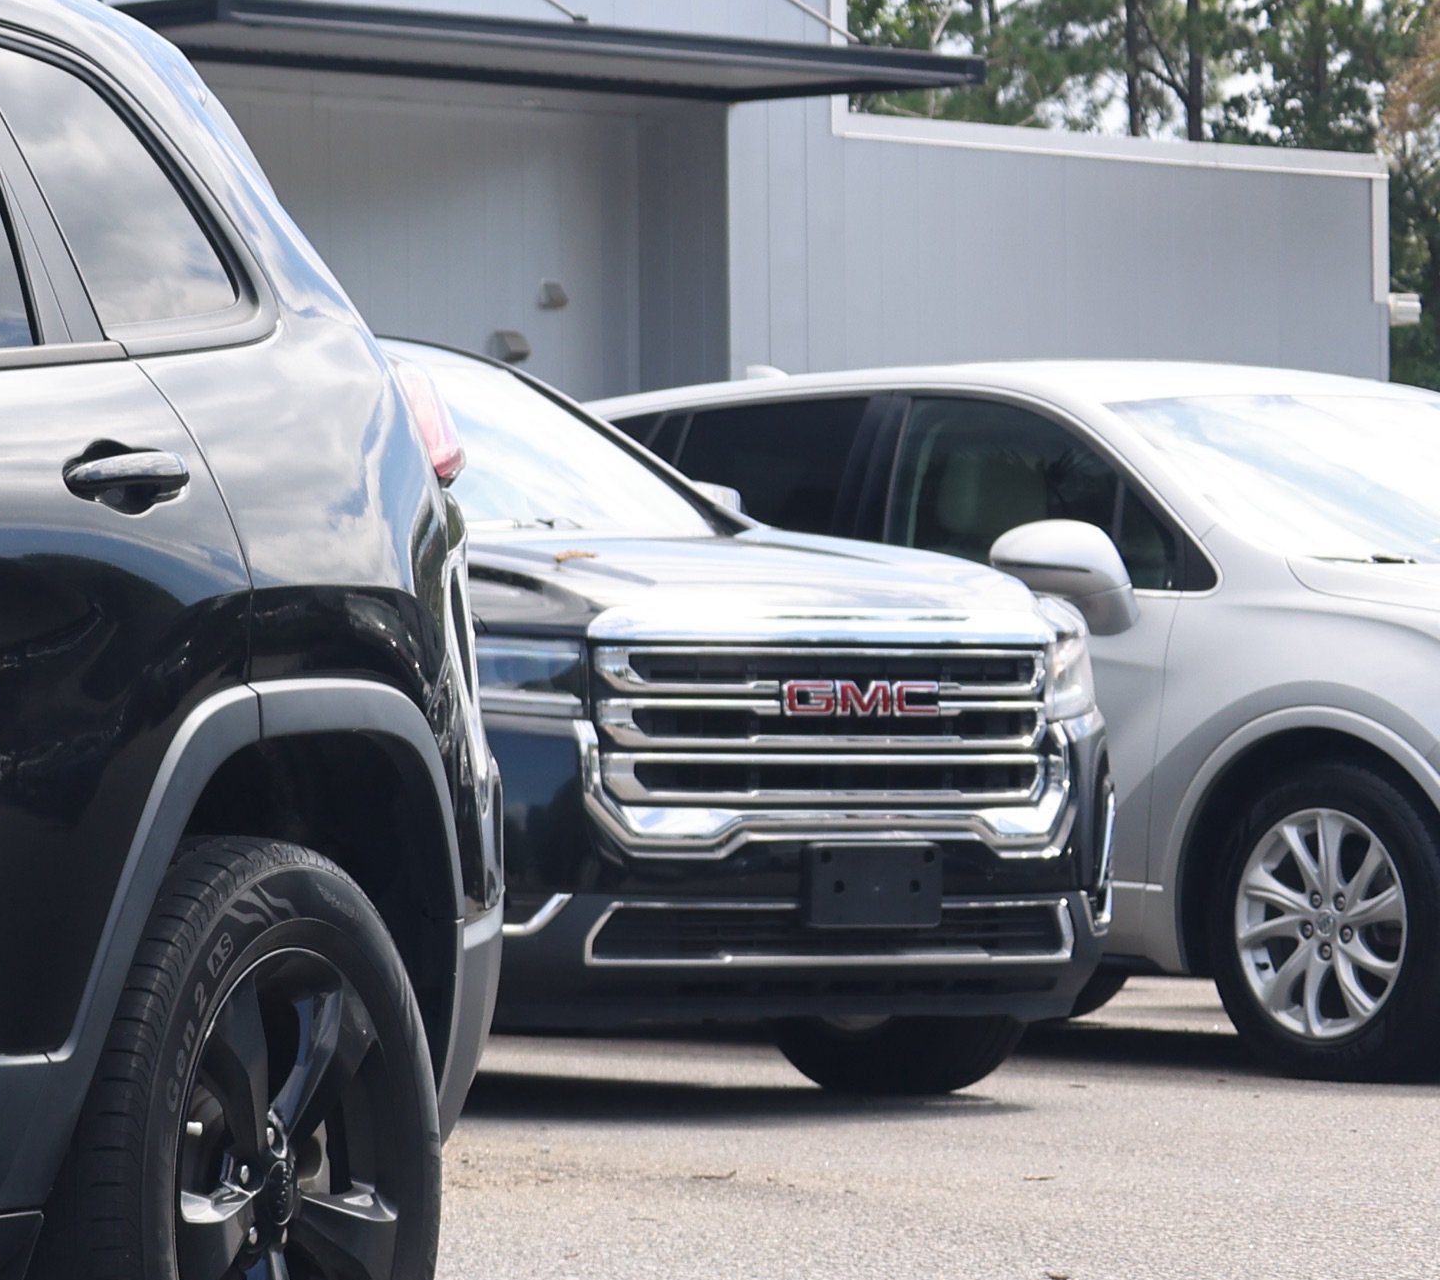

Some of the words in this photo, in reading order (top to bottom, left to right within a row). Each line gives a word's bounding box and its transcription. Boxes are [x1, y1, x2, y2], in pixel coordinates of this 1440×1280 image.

[782, 679, 940, 717] GMC
[165, 1019, 196, 1114] Gen
[193, 980, 208, 1018] 2
[210, 935, 233, 973] AS
